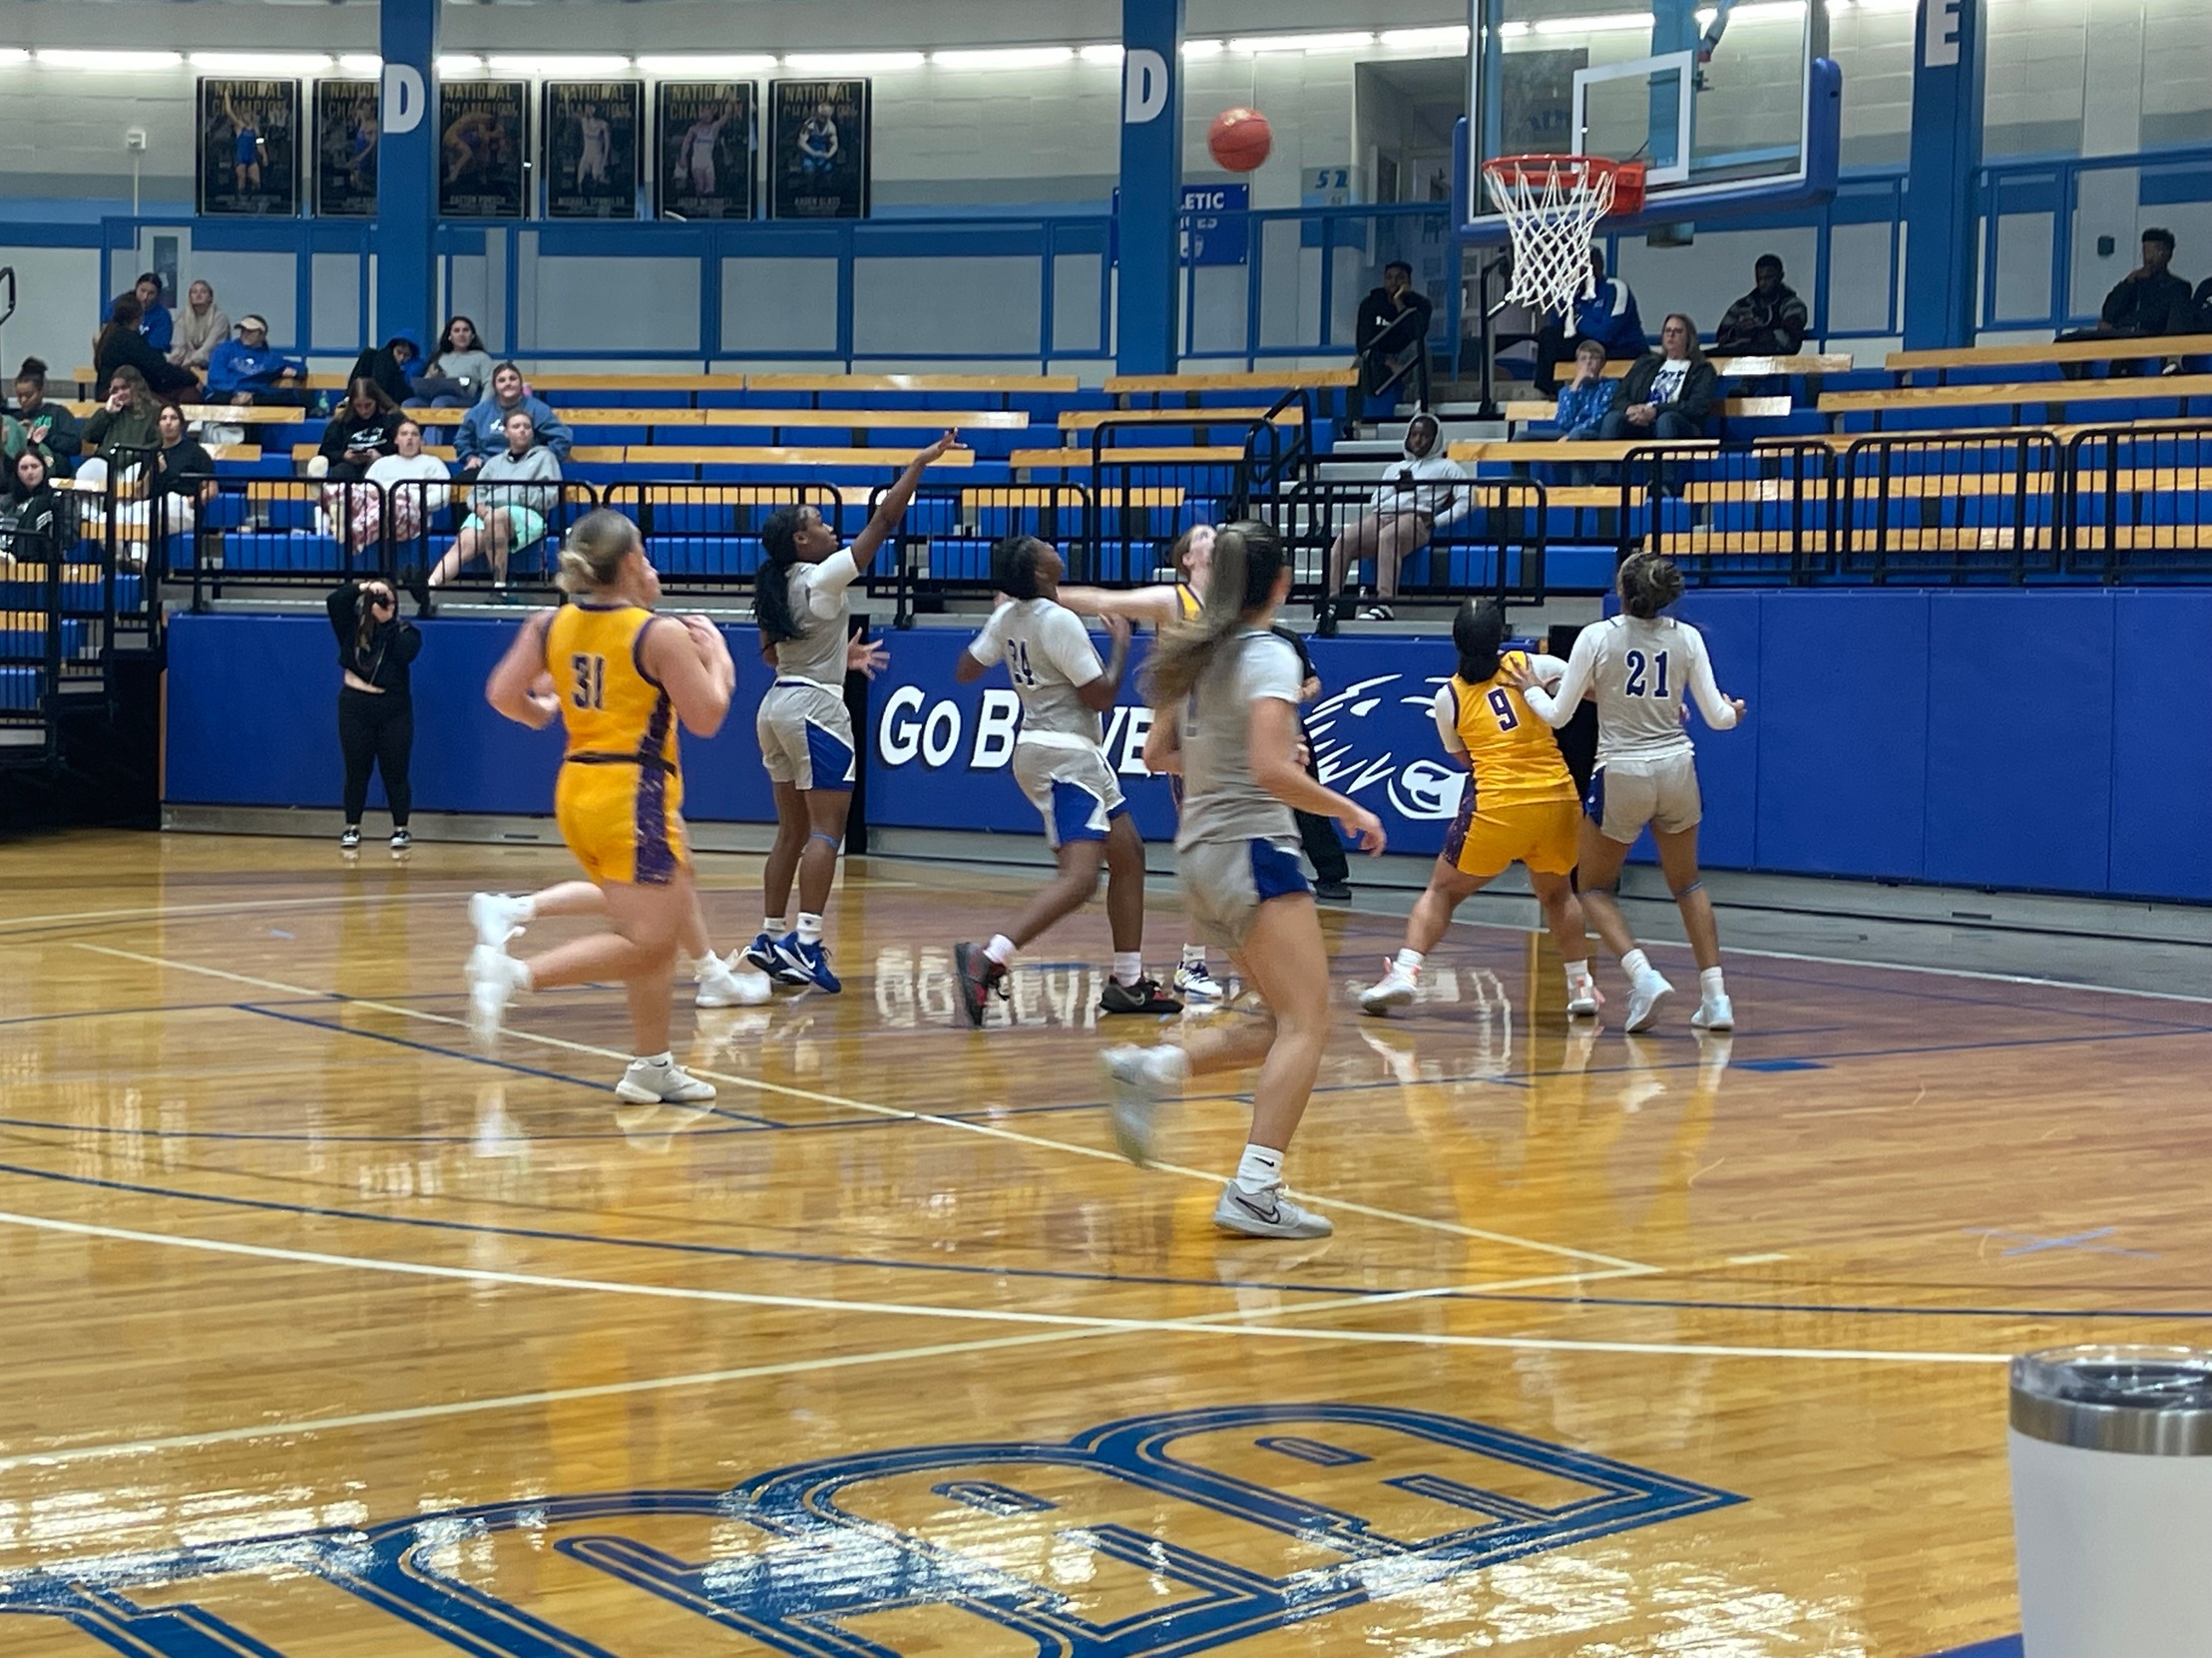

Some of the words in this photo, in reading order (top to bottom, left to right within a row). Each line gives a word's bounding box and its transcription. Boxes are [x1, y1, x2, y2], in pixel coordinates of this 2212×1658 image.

[1925, 0, 1960, 67] E
[383, 64, 425, 133] D
[1124, 49, 1168, 123] D
[1180, 192, 1225, 210] ETIC
[571, 653, 606, 710] 31
[1624, 649, 1672, 698] 21
[1486, 686, 1522, 733] 9
